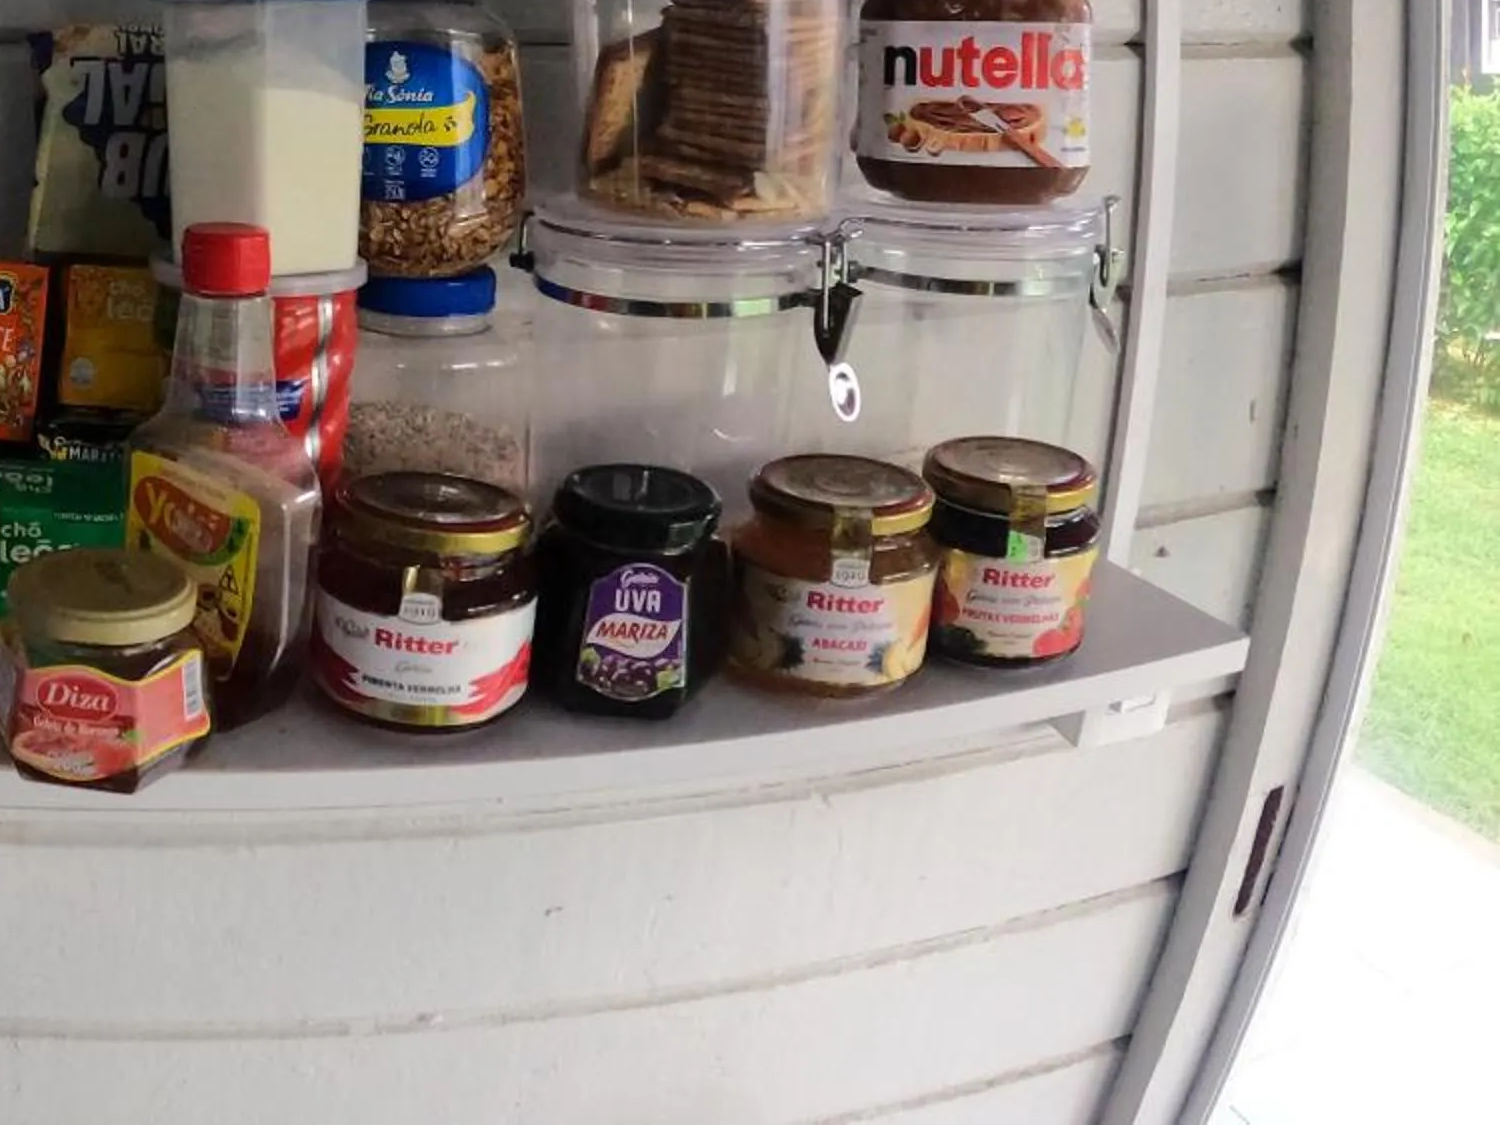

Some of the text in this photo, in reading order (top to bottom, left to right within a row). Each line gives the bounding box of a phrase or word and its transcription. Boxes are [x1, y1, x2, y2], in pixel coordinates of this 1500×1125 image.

[883, 30, 1085, 90] nutella
[982, 567, 1056, 589] Ritter
[615, 589, 662, 613] UVA
[806, 591, 885, 614] Ritter
[374, 628, 461, 655] Ritter
[596, 621, 668, 644] MARIZA
[44, 683, 110, 712] Diza
